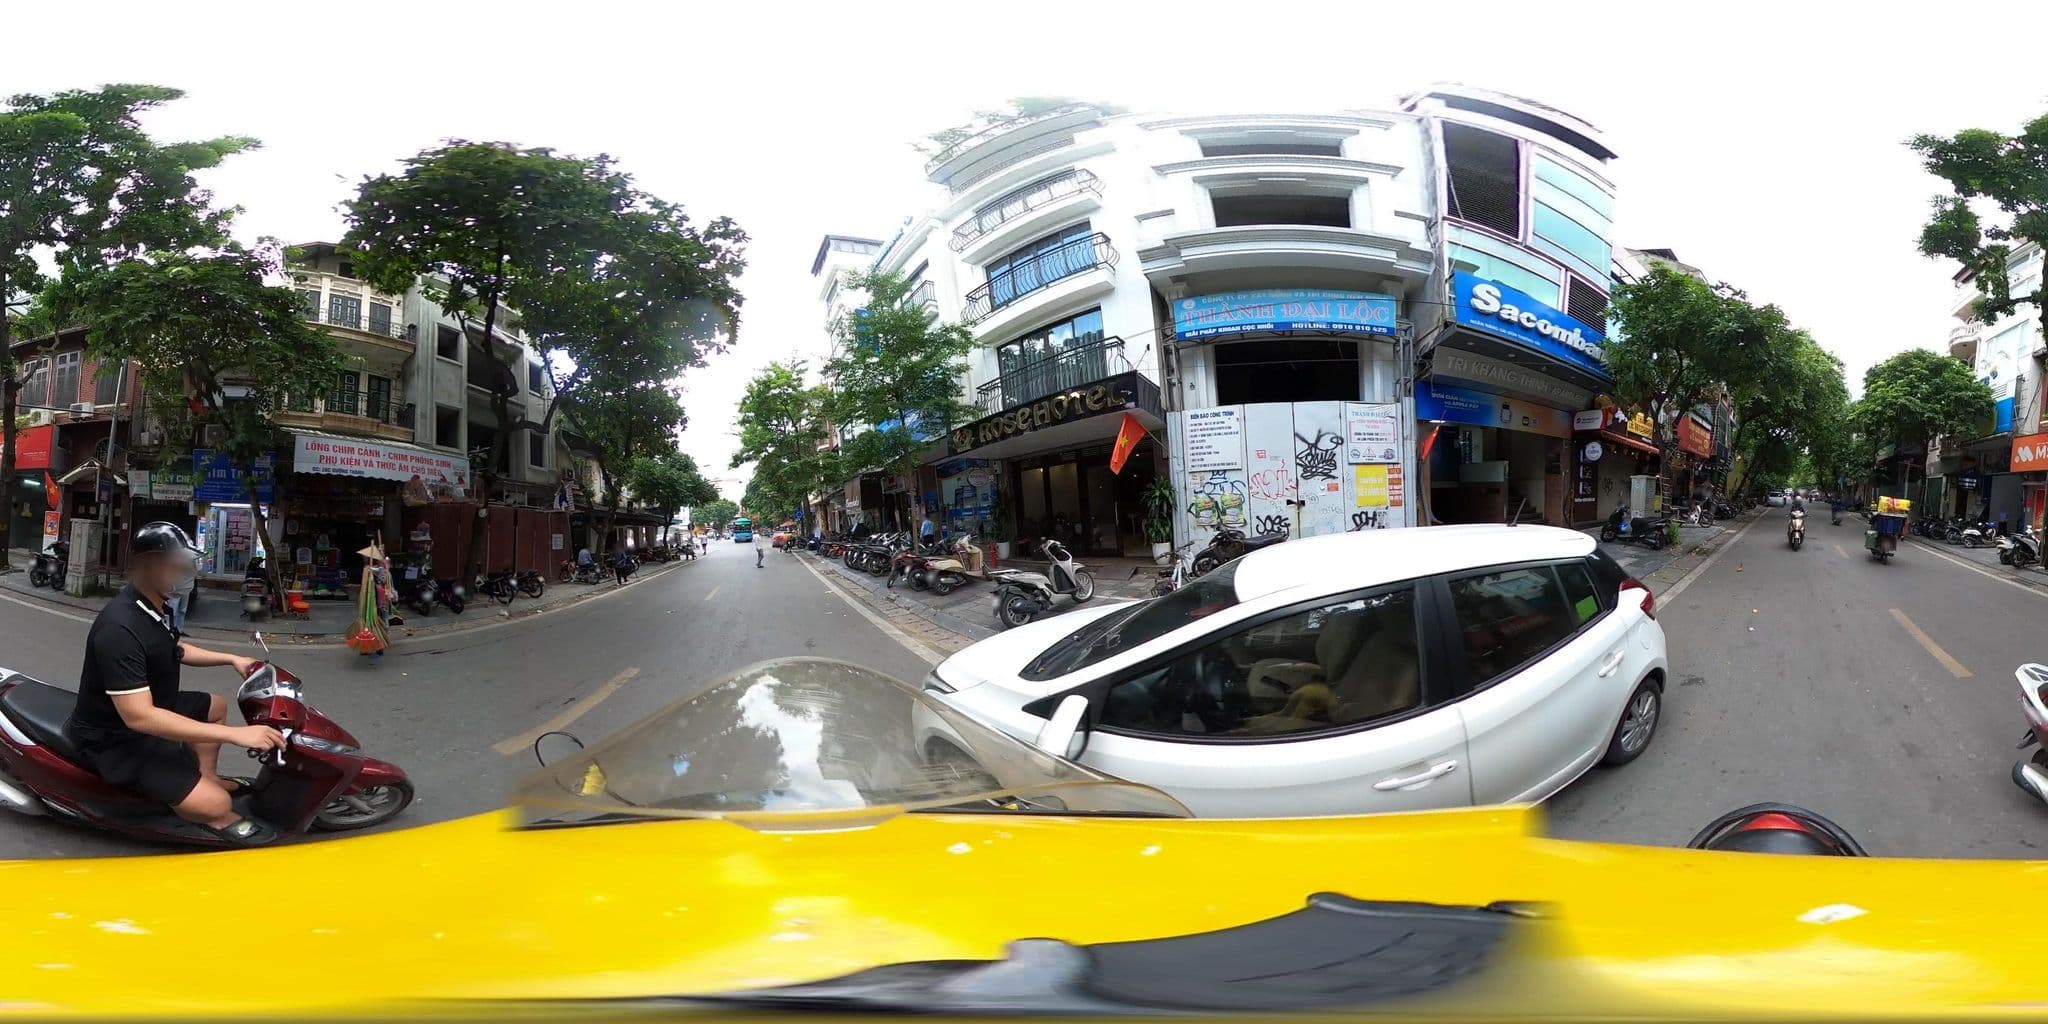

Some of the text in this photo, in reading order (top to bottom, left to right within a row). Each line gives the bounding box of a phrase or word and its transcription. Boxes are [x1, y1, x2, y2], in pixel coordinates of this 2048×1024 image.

[1181, 300, 1390, 326] THÀNH ĐẠI LỘC
[1470, 283, 1607, 362] Sacomban
[332, 444, 355, 454] CHIM
[388, 452, 409, 462] CHIM
